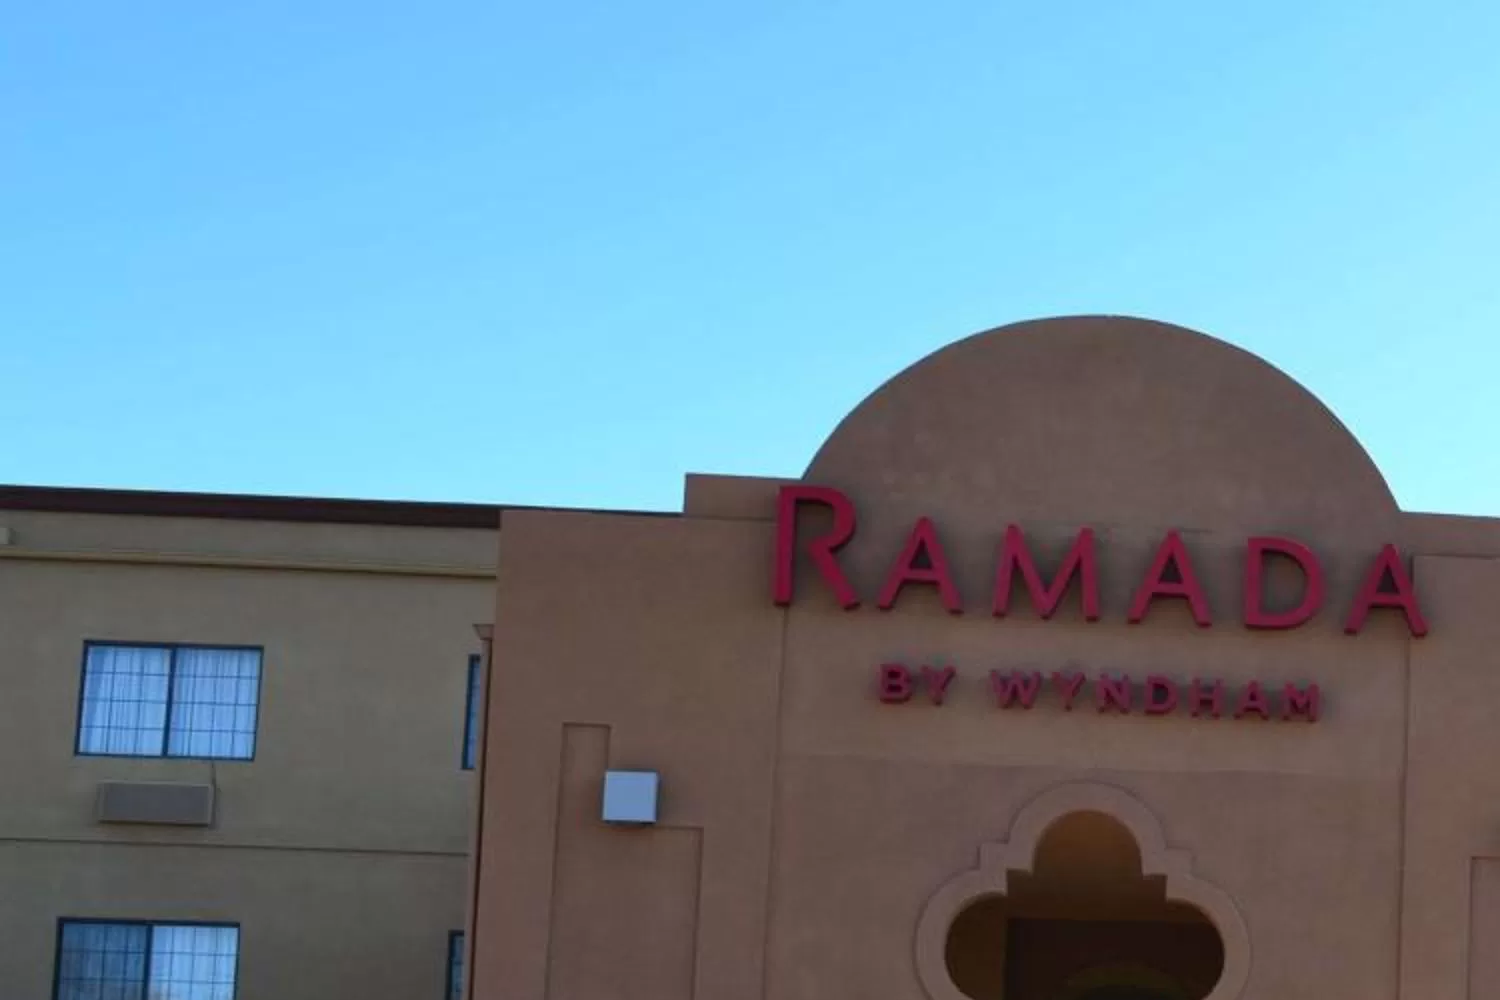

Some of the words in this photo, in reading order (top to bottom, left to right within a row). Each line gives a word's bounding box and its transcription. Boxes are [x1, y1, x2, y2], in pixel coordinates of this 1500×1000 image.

[772, 485, 1428, 637] RAMADA
[879, 662, 957, 706] BY
[990, 668, 1321, 722] WYNDHAM
